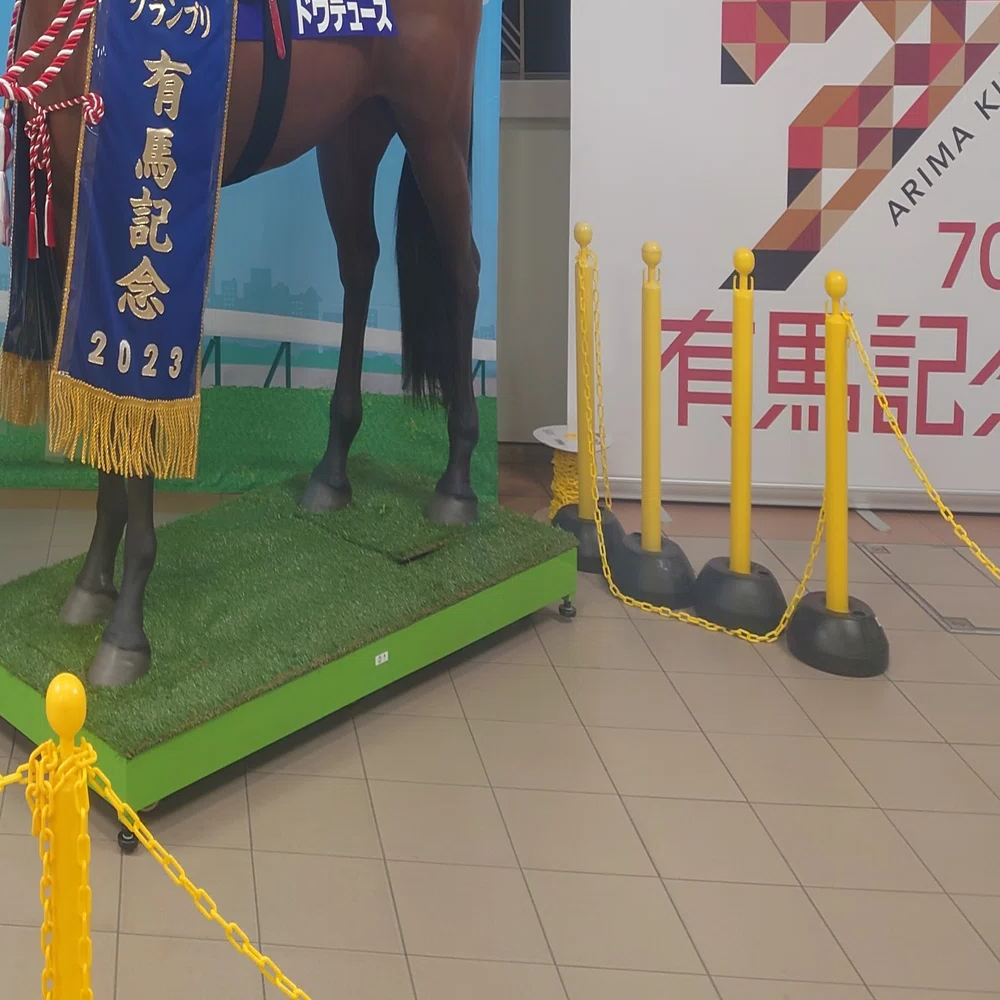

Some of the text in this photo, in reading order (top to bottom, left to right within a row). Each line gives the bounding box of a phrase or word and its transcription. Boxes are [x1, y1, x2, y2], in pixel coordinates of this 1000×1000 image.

[116, 49, 192, 321] 有馬記念
[887, 125, 975, 228] ARIMA
[88, 330, 184, 379] 2023
